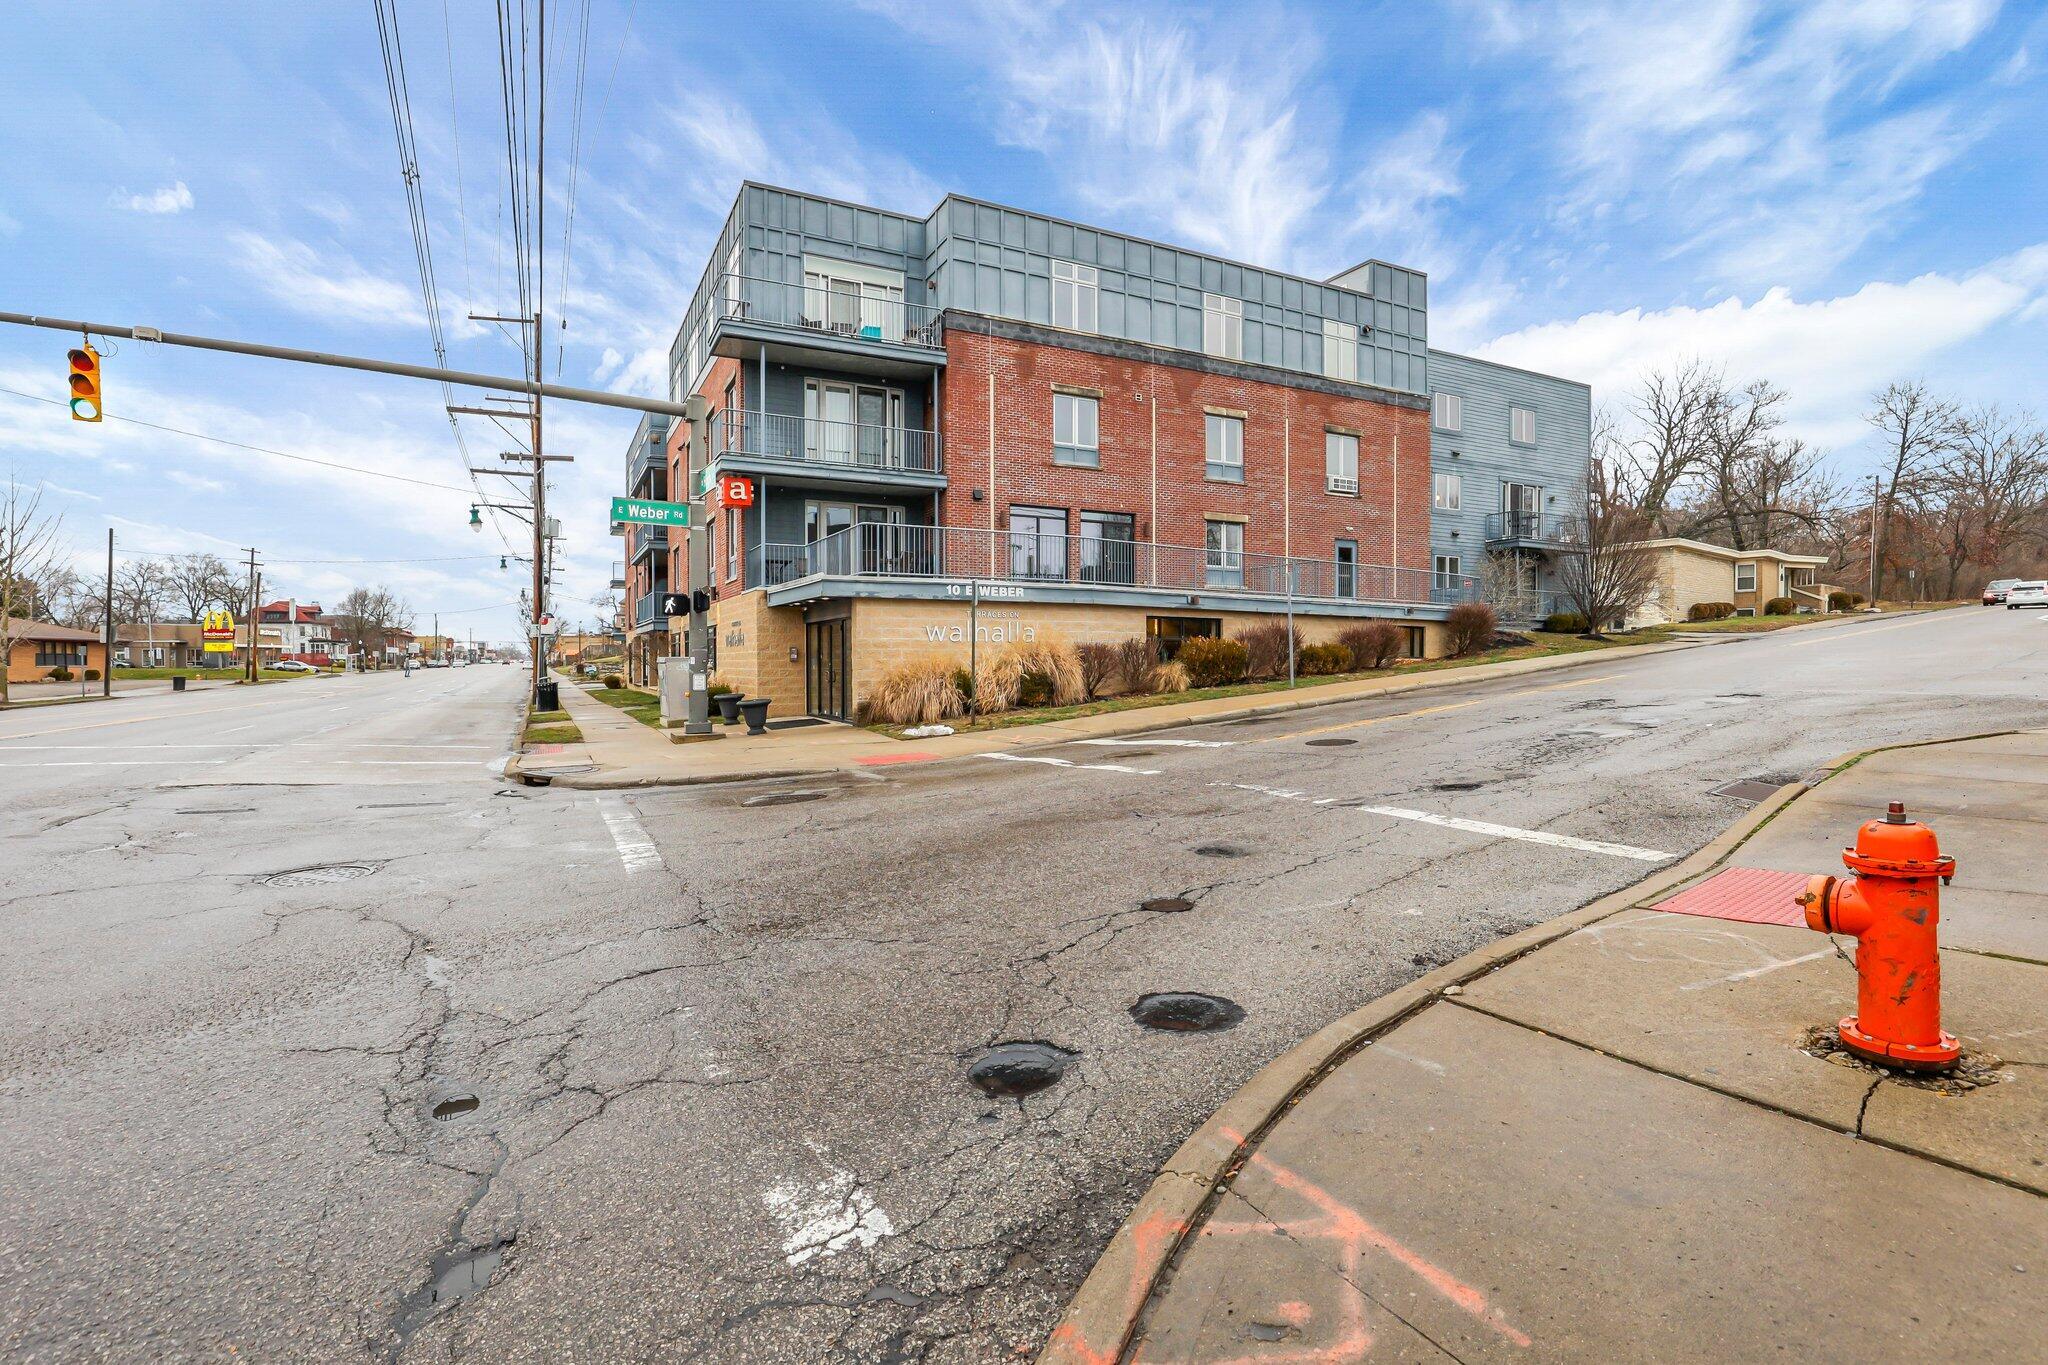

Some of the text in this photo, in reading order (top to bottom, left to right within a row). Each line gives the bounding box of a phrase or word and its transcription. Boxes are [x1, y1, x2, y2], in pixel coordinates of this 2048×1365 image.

[729, 481, 747, 499] a
[618, 504, 683, 520] E Weber Rd
[946, 585, 1024, 597] 10 E WEBER
[966, 610, 1020, 619] TRRACES ON
[926, 621, 1035, 643] walhalla
